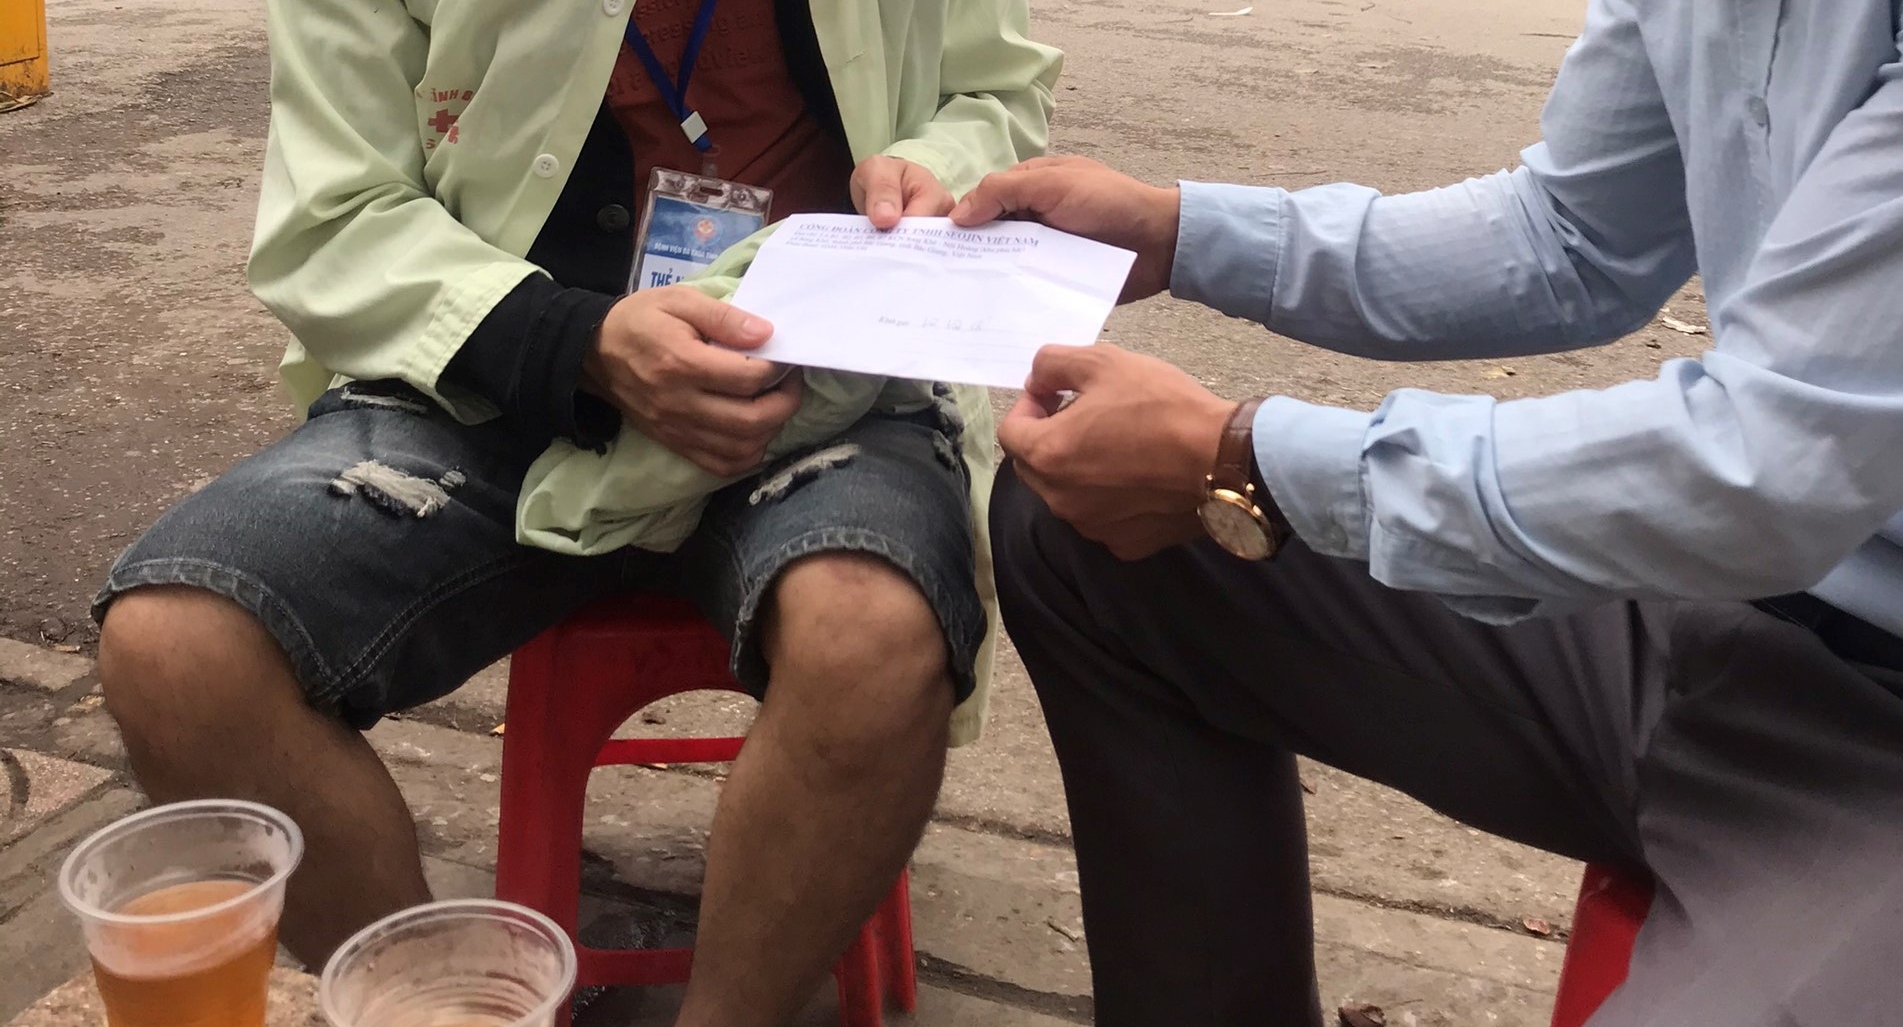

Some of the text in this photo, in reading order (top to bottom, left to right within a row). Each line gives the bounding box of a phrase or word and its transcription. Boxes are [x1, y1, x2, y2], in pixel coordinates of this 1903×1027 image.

[913, 228, 942, 236] TNHH
[945, 230, 982, 242] SEOJIN
[986, 235, 1010, 246] VIỆT
[1014, 237, 1039, 247] NAM
